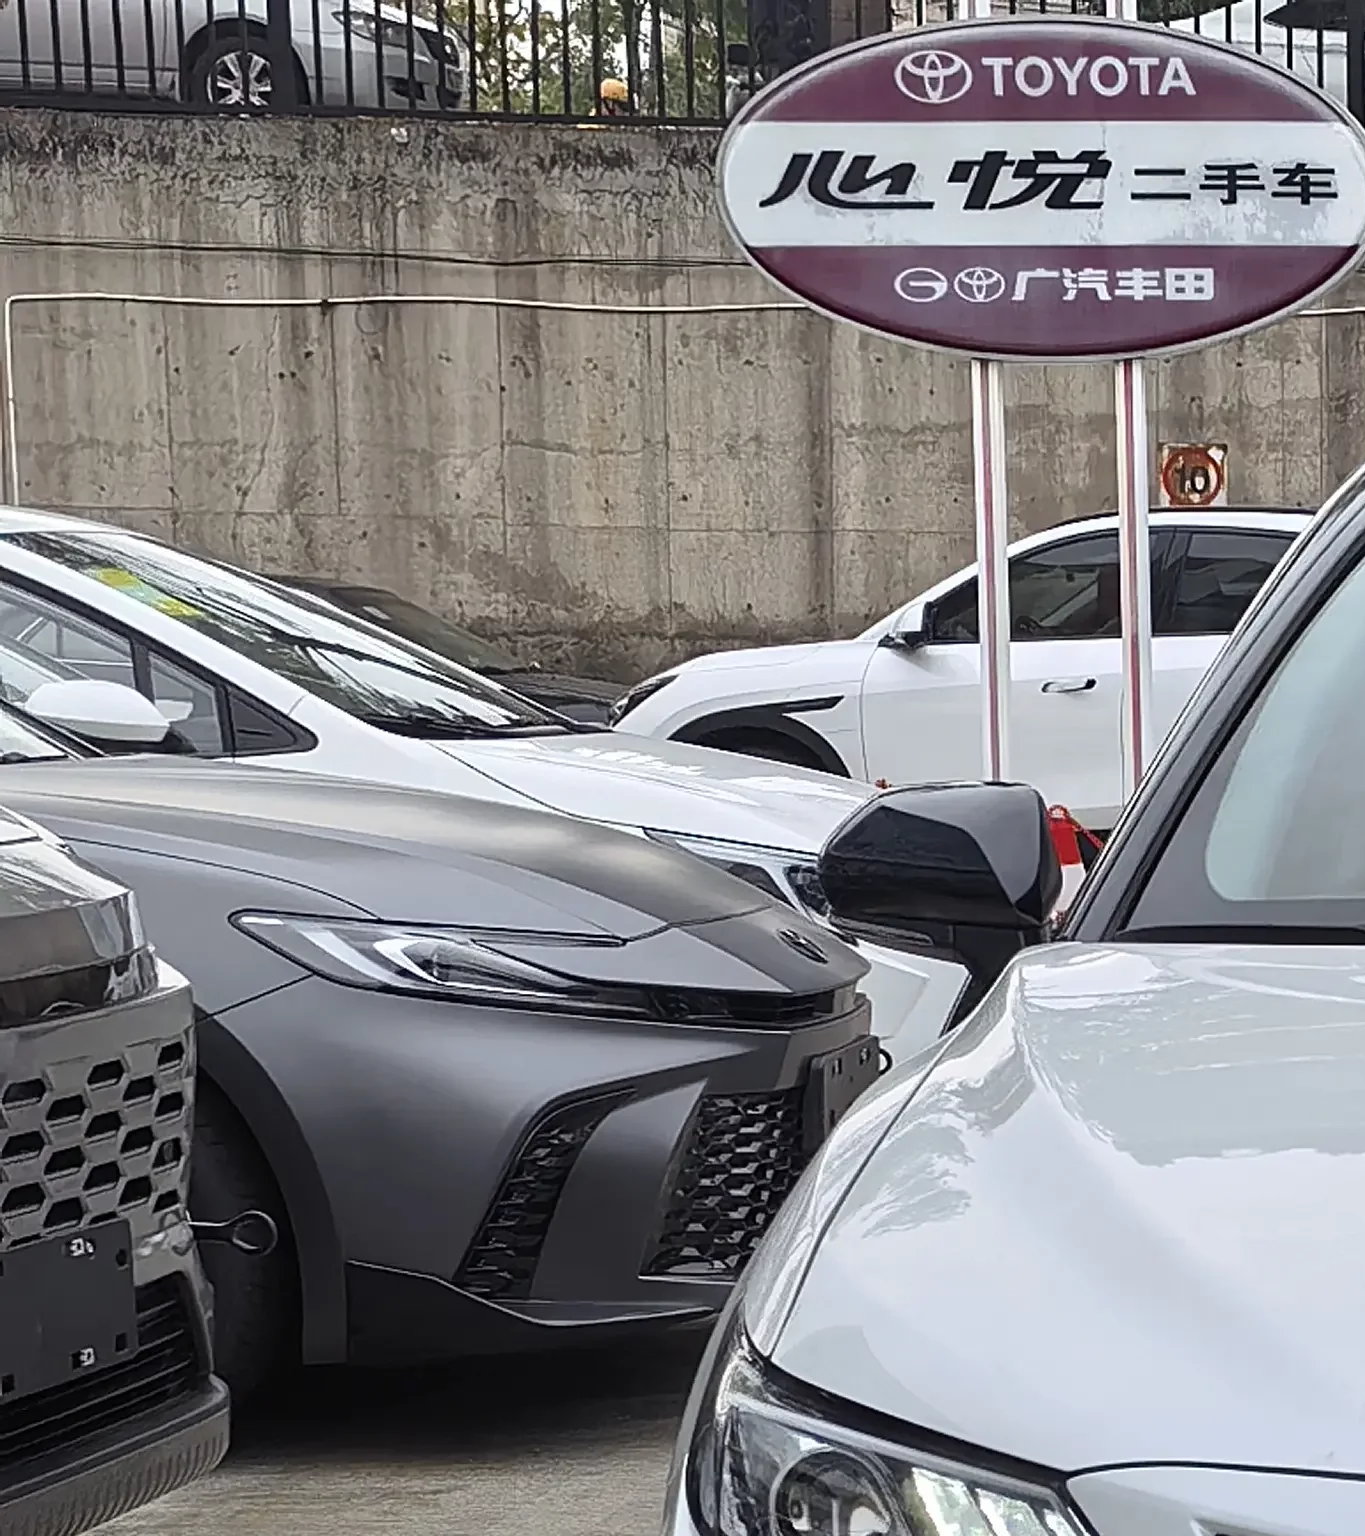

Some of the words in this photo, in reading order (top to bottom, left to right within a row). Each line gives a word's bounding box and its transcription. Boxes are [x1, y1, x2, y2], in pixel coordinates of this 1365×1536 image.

[982, 56, 1196, 97] TOYOTA
[1011, 267, 1215, 302] 广汽丰田
